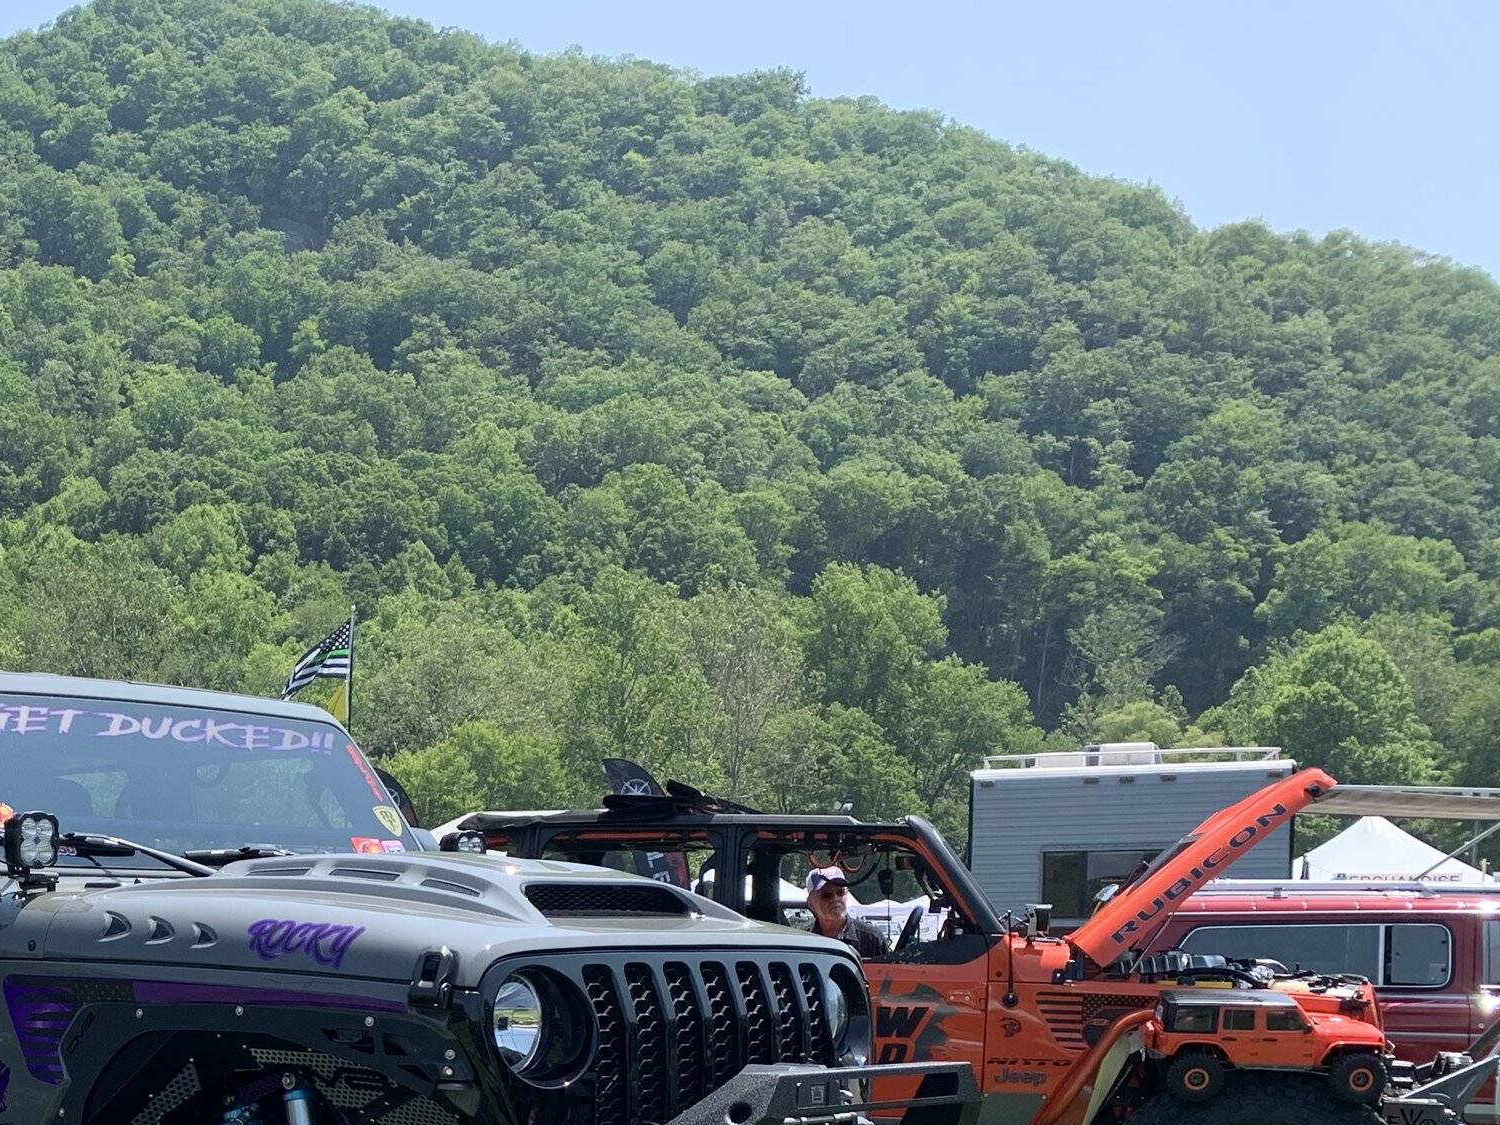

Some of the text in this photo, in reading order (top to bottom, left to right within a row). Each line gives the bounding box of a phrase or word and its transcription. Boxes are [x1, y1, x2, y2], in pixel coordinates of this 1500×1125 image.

[93, 711, 335, 755] DUCKED!!
[1111, 803, 1287, 944] RUBICON
[247, 919, 367, 970] ROCKY
[995, 1068, 1047, 1085] Jeep
